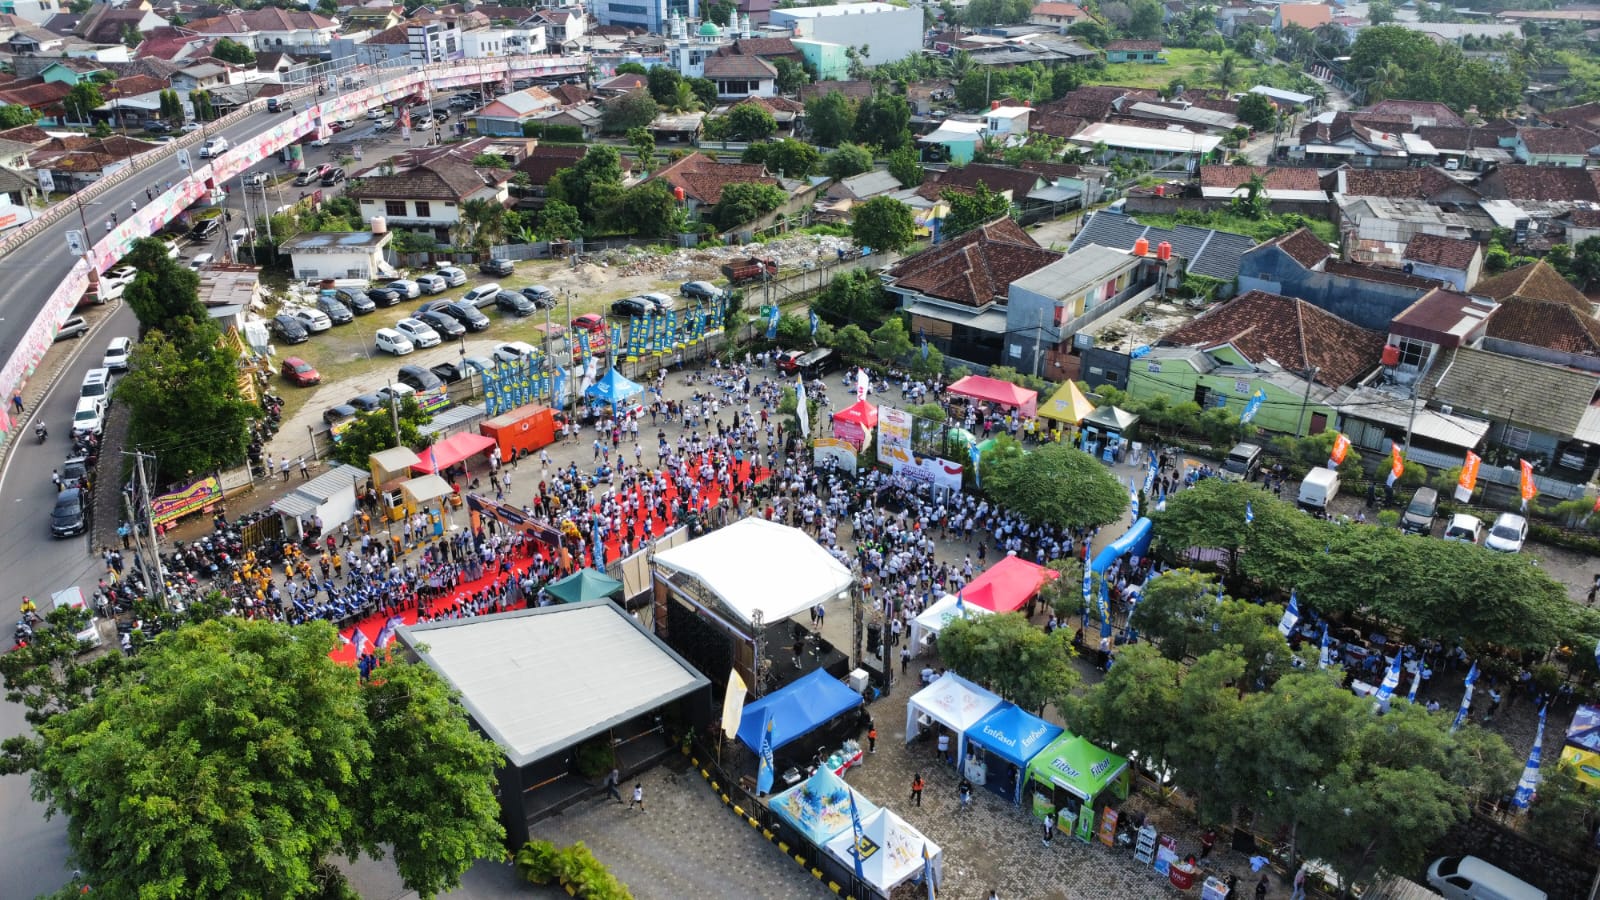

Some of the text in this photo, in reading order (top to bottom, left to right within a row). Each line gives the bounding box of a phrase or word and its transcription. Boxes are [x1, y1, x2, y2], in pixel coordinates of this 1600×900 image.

[983, 725, 1017, 747] Entrasol
[1051, 758, 1080, 777] Fitbar
[1091, 757, 1110, 779] Fitbar
